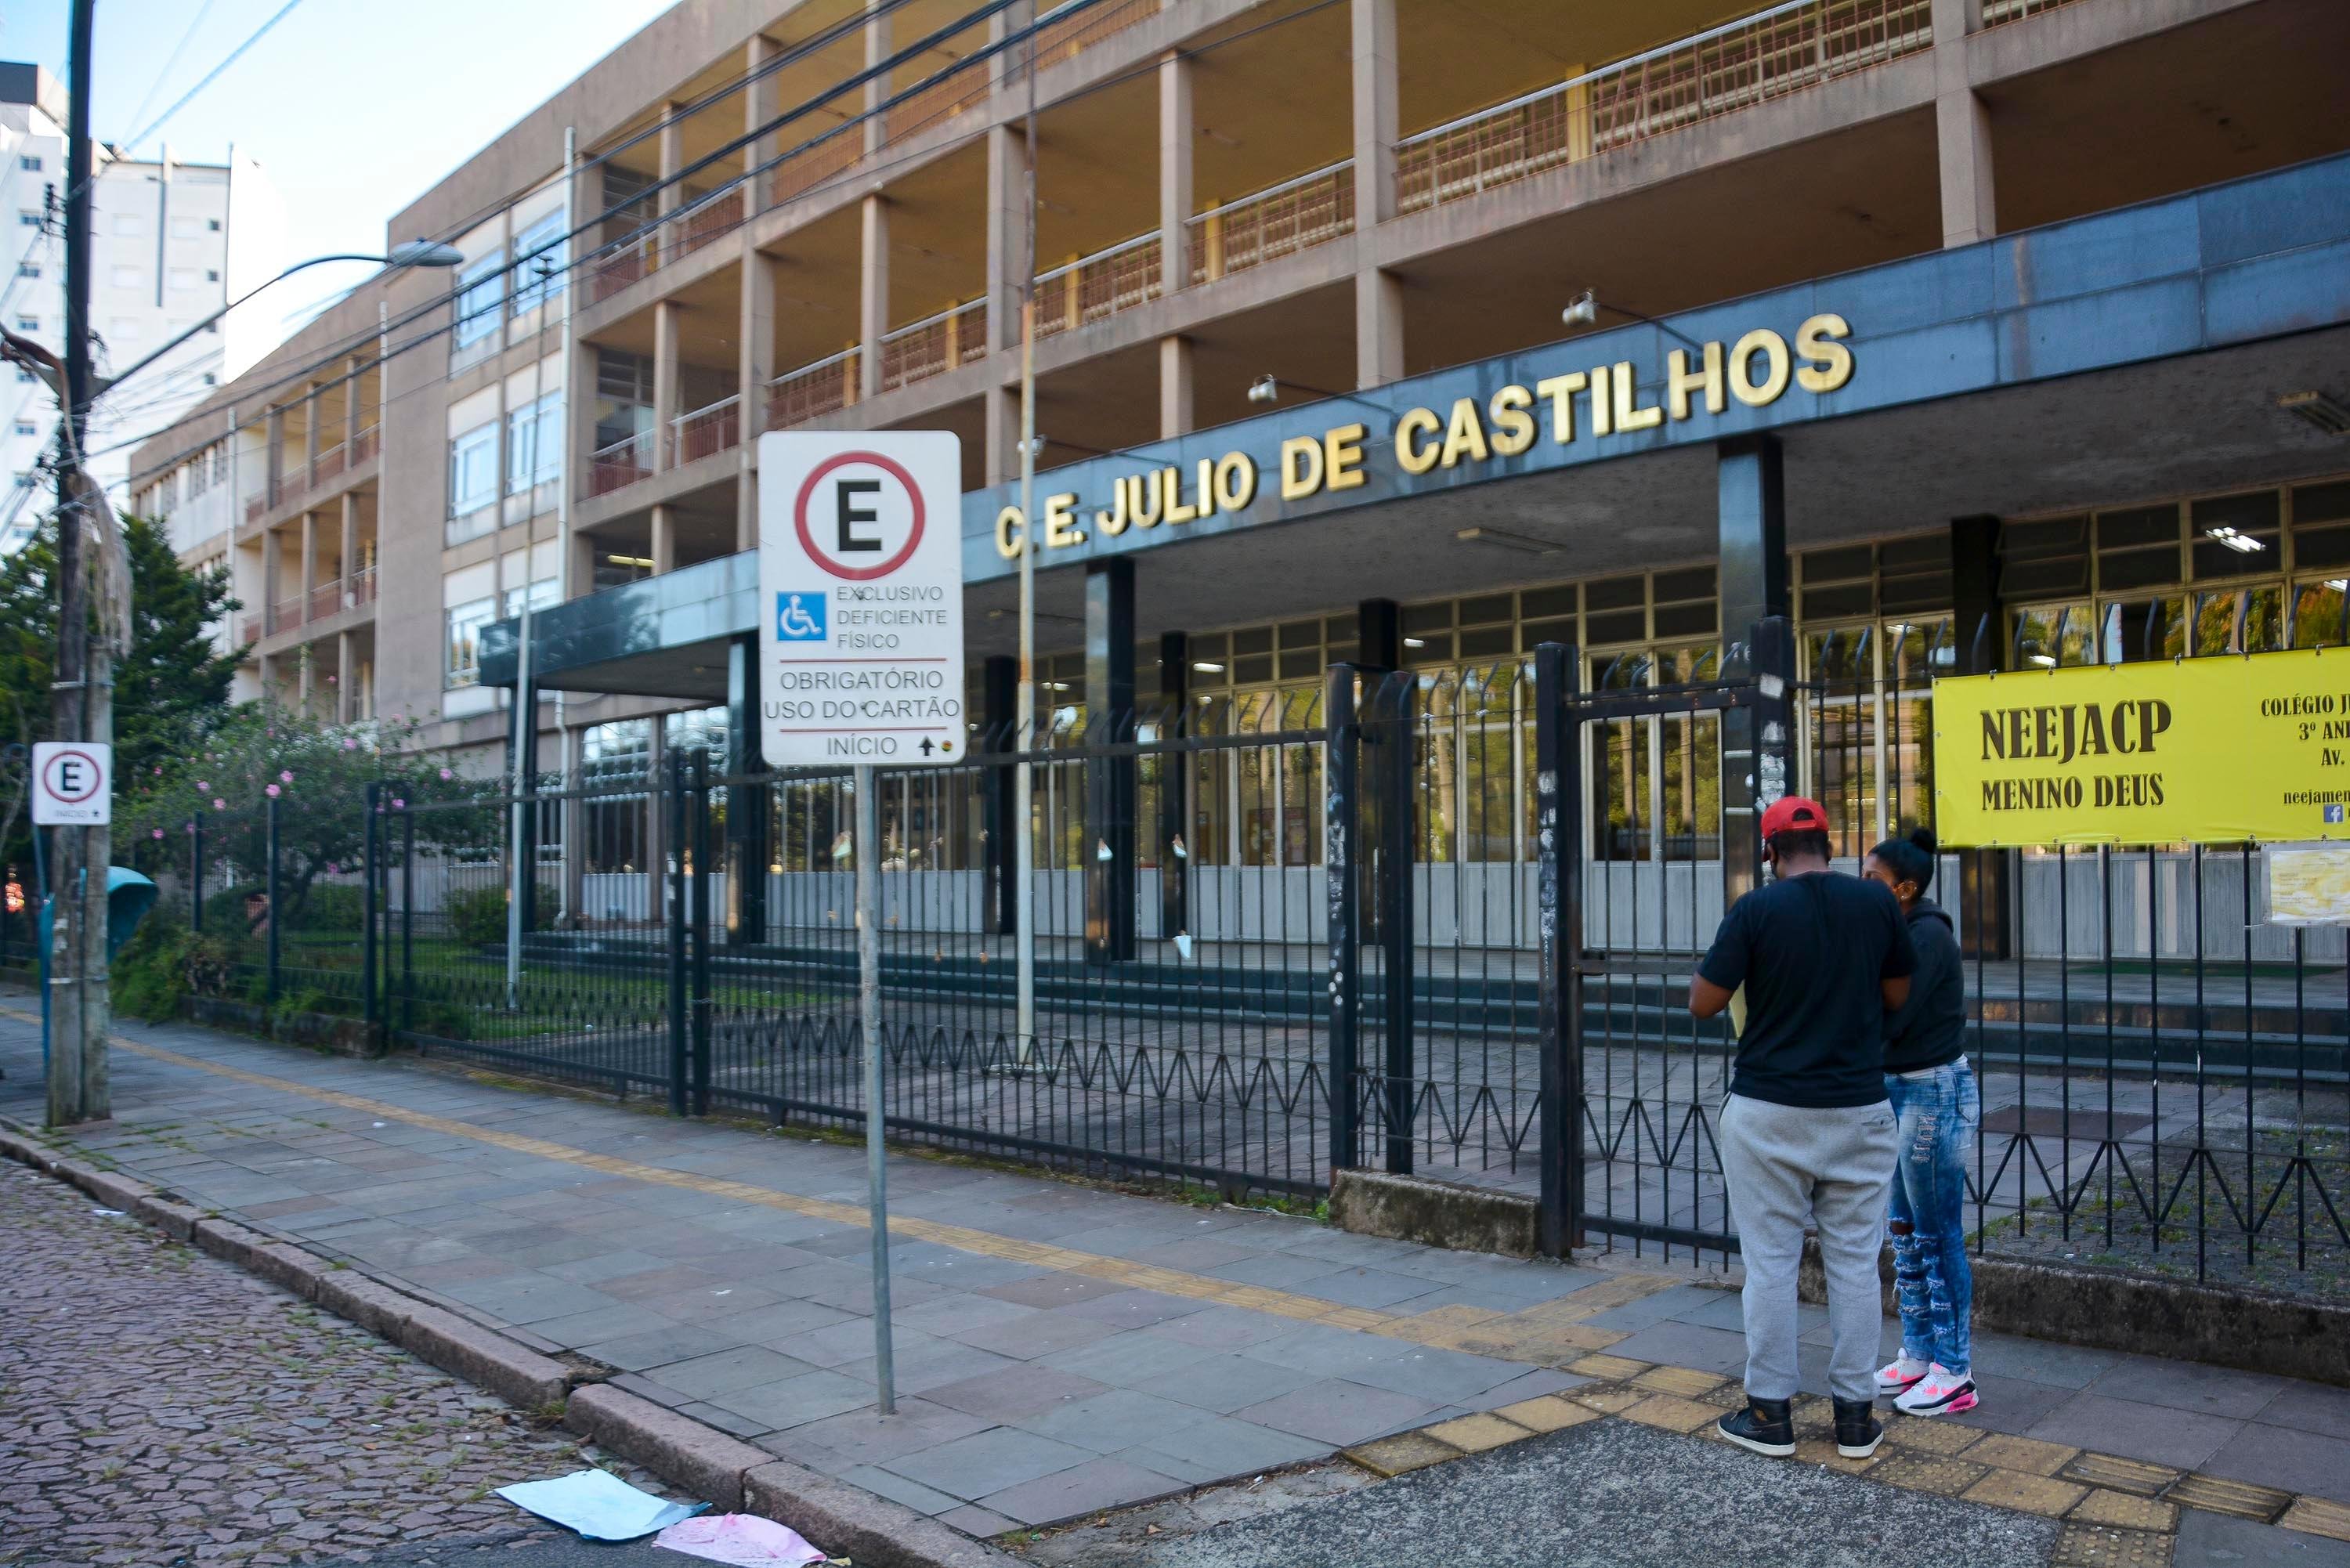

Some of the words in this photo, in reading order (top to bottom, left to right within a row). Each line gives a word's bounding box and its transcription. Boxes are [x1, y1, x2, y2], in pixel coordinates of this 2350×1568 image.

[996, 505, 1031, 559] C
[1045, 492, 1084, 548] E.
[1096, 450, 1256, 537] JULIO
[1280, 423, 1366, 501] DE
[1394, 313, 1855, 475] CASTILHOS
[836, 479, 882, 551] E
[837, 586, 943, 601] EXCLUSIVO
[837, 609, 947, 624] DEFICIENTE
[837, 630, 900, 649] FÍSICO
[780, 667, 943, 690] OBRIGATÓRIO
[765, 700, 815, 719] USO
[823, 701, 856, 718] DO
[865, 695, 960, 717] CARTÃO
[2261, 692, 2334, 717] COLÉGIO
[2340, 693, 2350, 714] J
[1980, 698, 2171, 764] NEEJACP
[828, 733, 897, 755] INÍCIO
[61, 761, 81, 791] E
[1982, 776, 2083, 811] MENINO
[2094, 772, 2164, 807] DEUS
